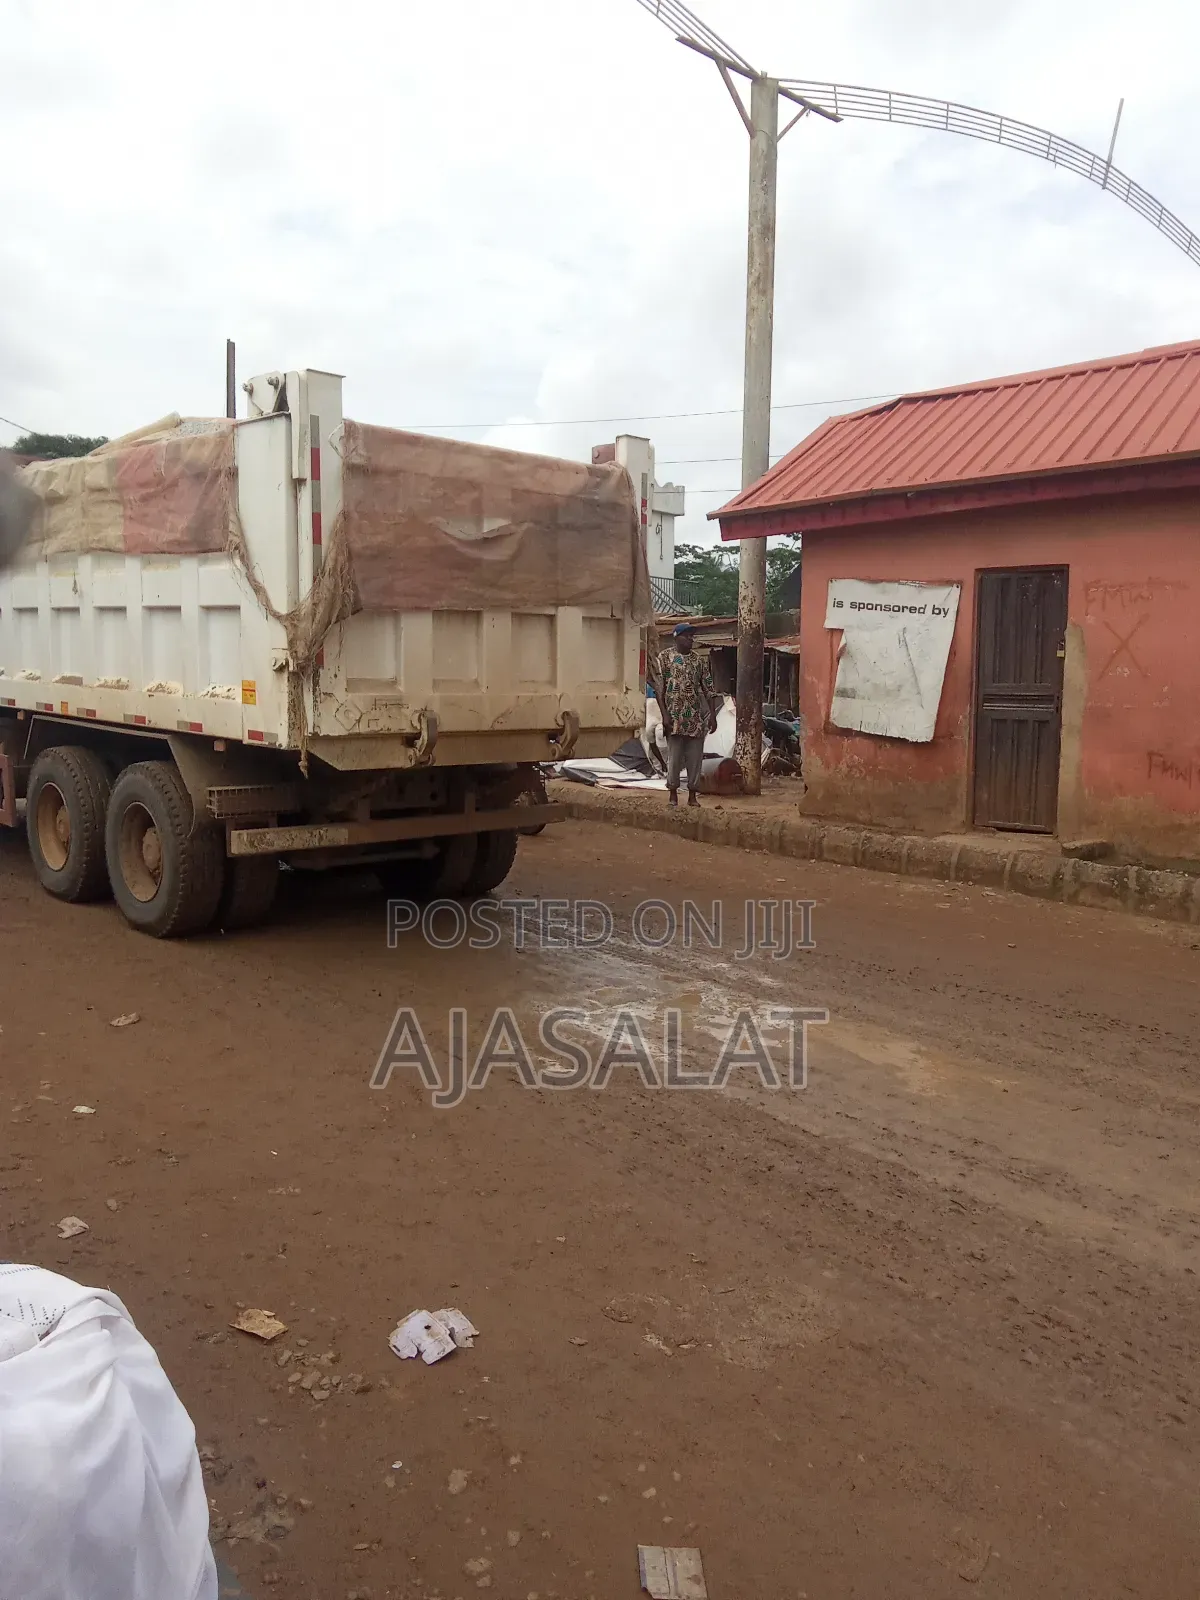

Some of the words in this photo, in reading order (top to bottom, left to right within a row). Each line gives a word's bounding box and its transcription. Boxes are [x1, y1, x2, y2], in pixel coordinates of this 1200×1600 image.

[832, 598, 844, 608] is
[849, 601, 927, 614] sponsored
[931, 604, 950, 618] by
